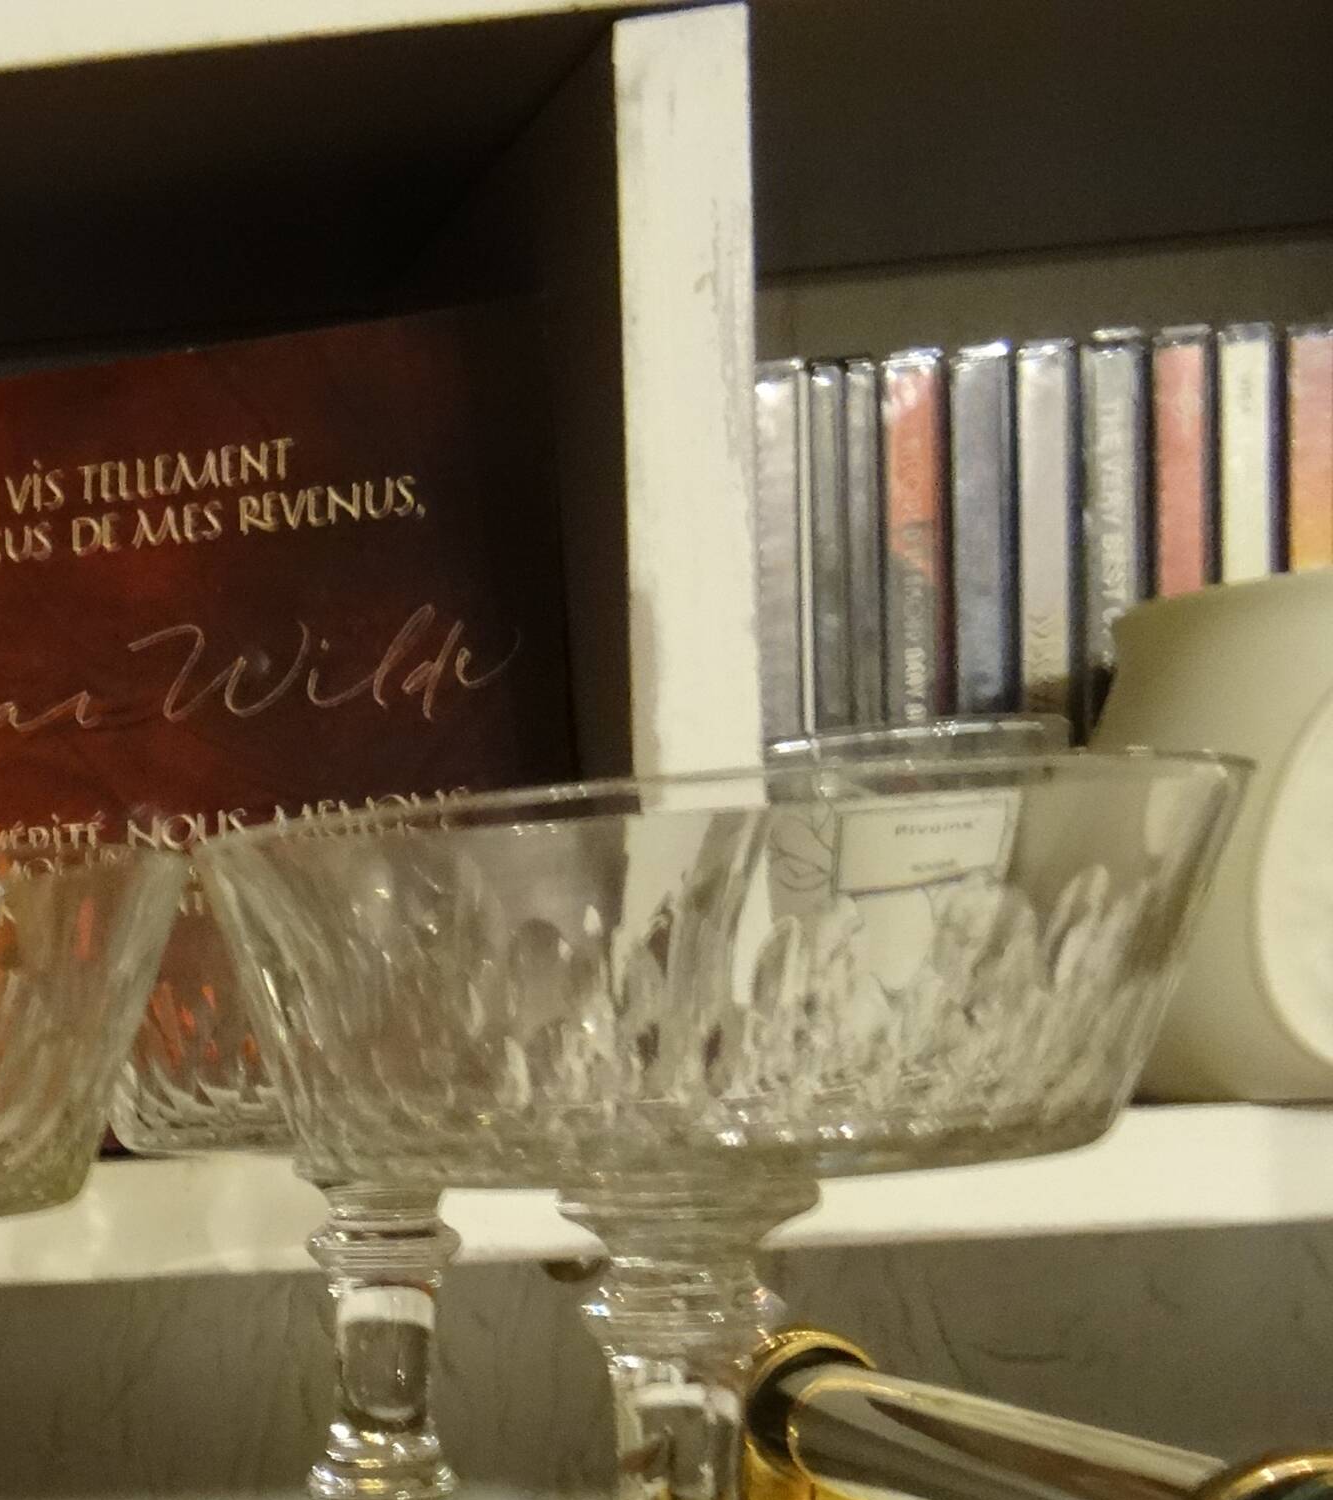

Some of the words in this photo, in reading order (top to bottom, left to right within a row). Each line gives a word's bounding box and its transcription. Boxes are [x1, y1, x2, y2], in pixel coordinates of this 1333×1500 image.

[78, 438, 294, 504] TELLEMENT
[71, 512, 120, 557] DE
[133, 500, 223, 549] MES
[128, 603, 521, 722] Wilde
